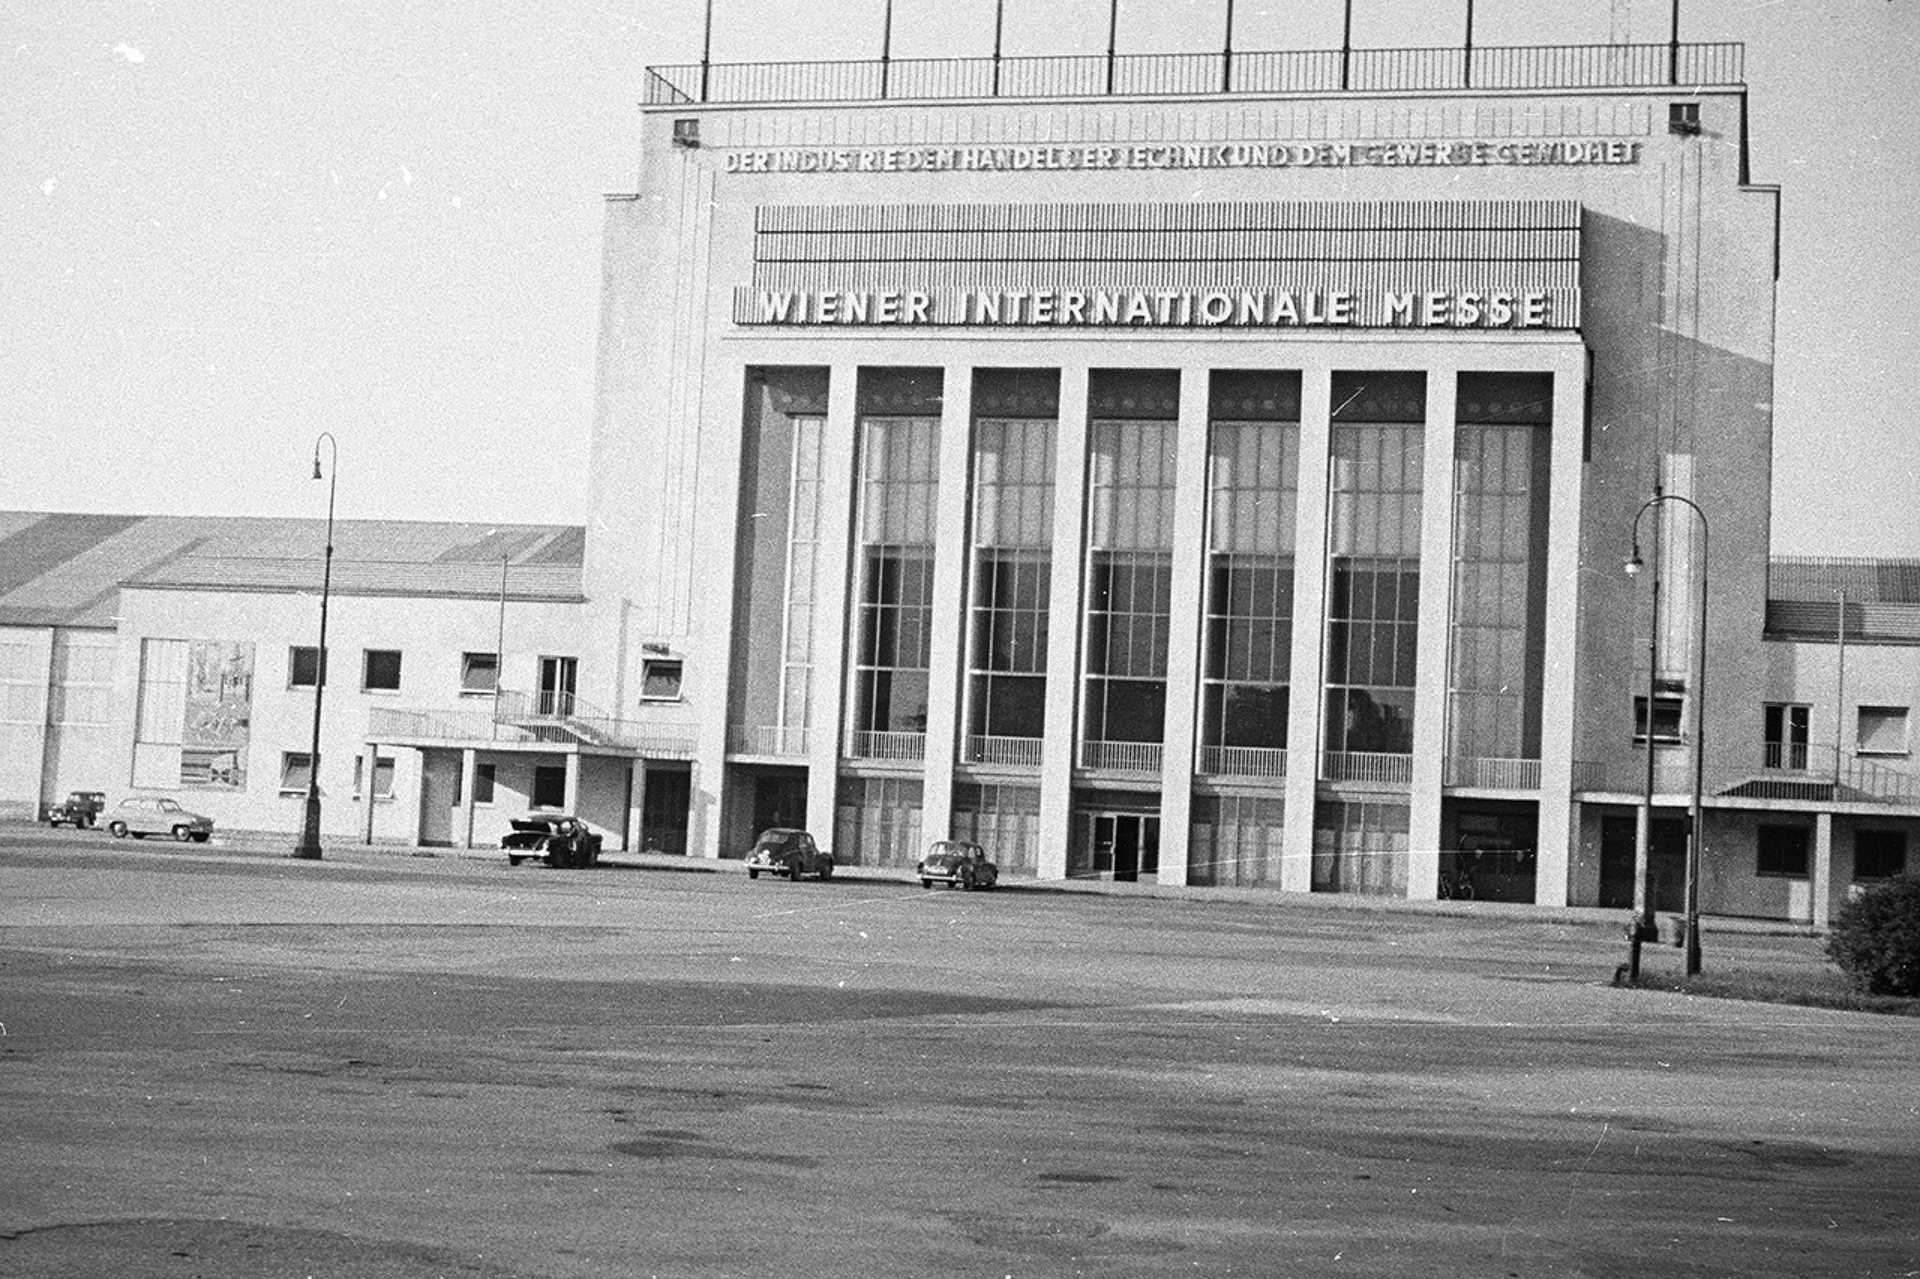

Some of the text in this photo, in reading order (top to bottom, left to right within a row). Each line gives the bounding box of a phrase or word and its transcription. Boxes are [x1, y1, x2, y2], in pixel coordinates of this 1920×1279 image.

[724, 150, 768, 172] DER
[774, 149, 900, 172] INDUSRIE
[962, 148, 1060, 170] HANDEL
[1235, 145, 1289, 167] UND
[758, 289, 1547, 327] WIENER INTERNATIONALE MESSE
